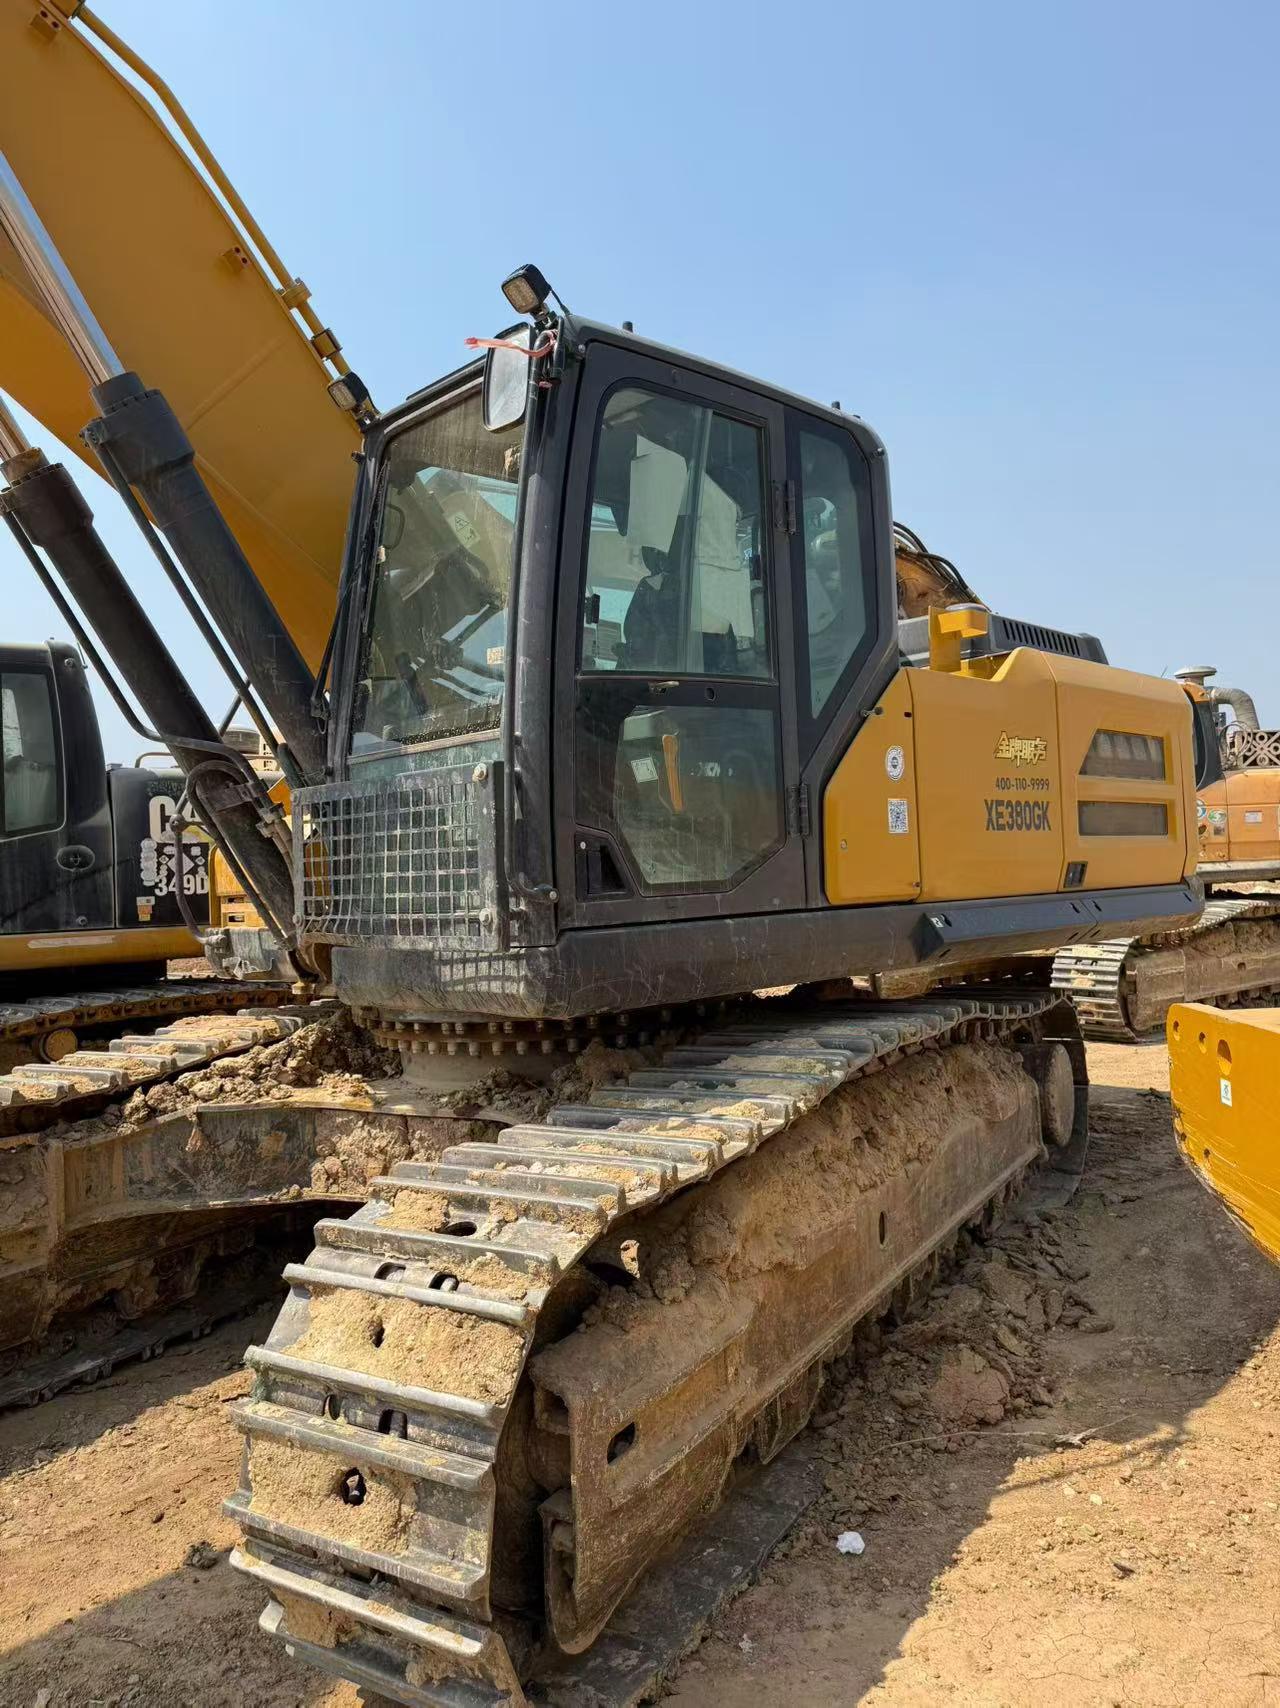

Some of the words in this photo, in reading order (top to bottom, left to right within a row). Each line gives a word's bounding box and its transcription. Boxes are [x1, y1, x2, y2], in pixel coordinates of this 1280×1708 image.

[993, 730, 1047, 767] 金牌服务
[995, 777, 1050, 791] 400-110-9999
